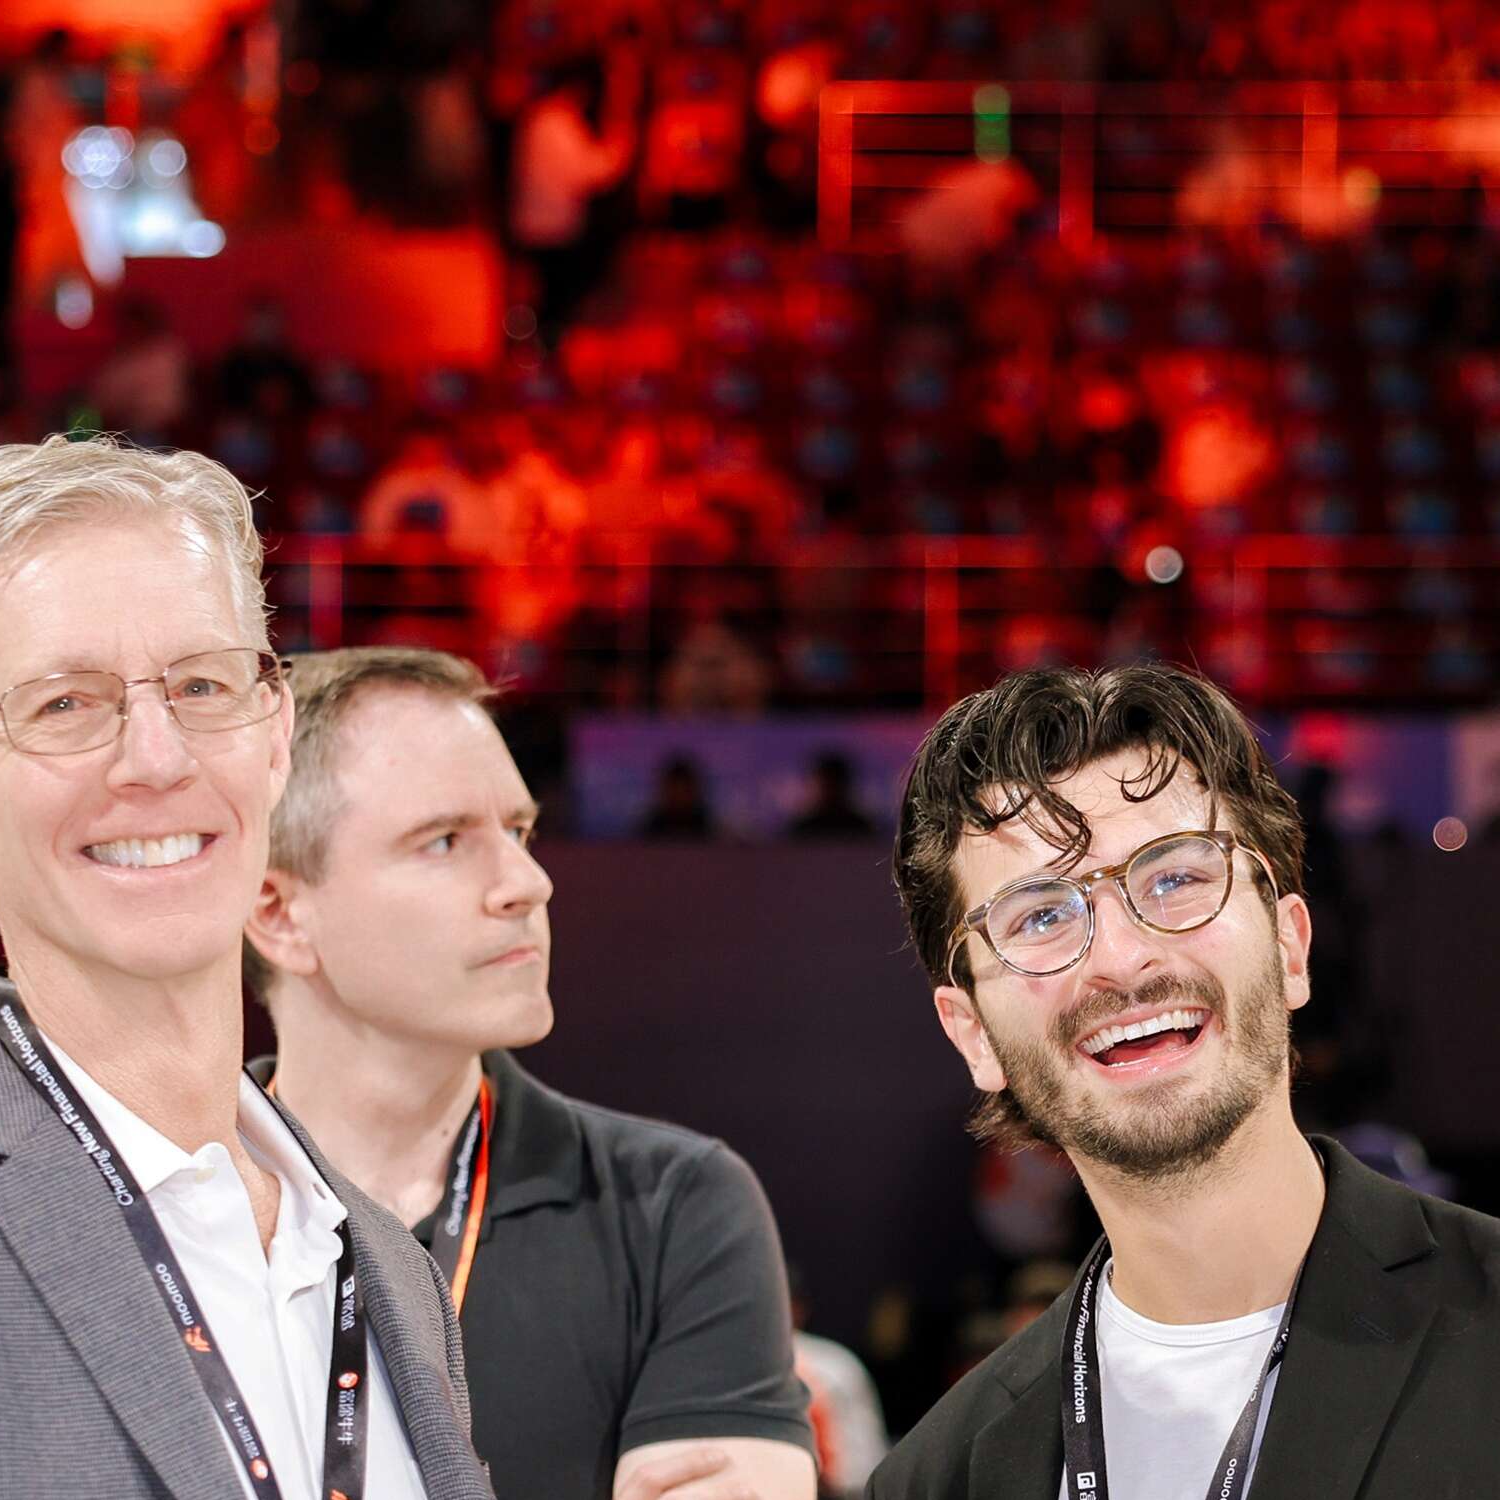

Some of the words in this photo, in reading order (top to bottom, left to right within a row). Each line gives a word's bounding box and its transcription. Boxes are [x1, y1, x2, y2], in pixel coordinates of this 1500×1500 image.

[0, 1003, 39, 1066] Horizons
[27, 1060, 80, 1125] Financial
[74, 1121, 102, 1154] New
[93, 1149, 134, 1207] Charting
[155, 1262, 195, 1327] moomoo
[1079, 1276, 1094, 1309] New
[1073, 1307, 1091, 1364] Financial
[1073, 1364, 1089, 1425] Horizons
